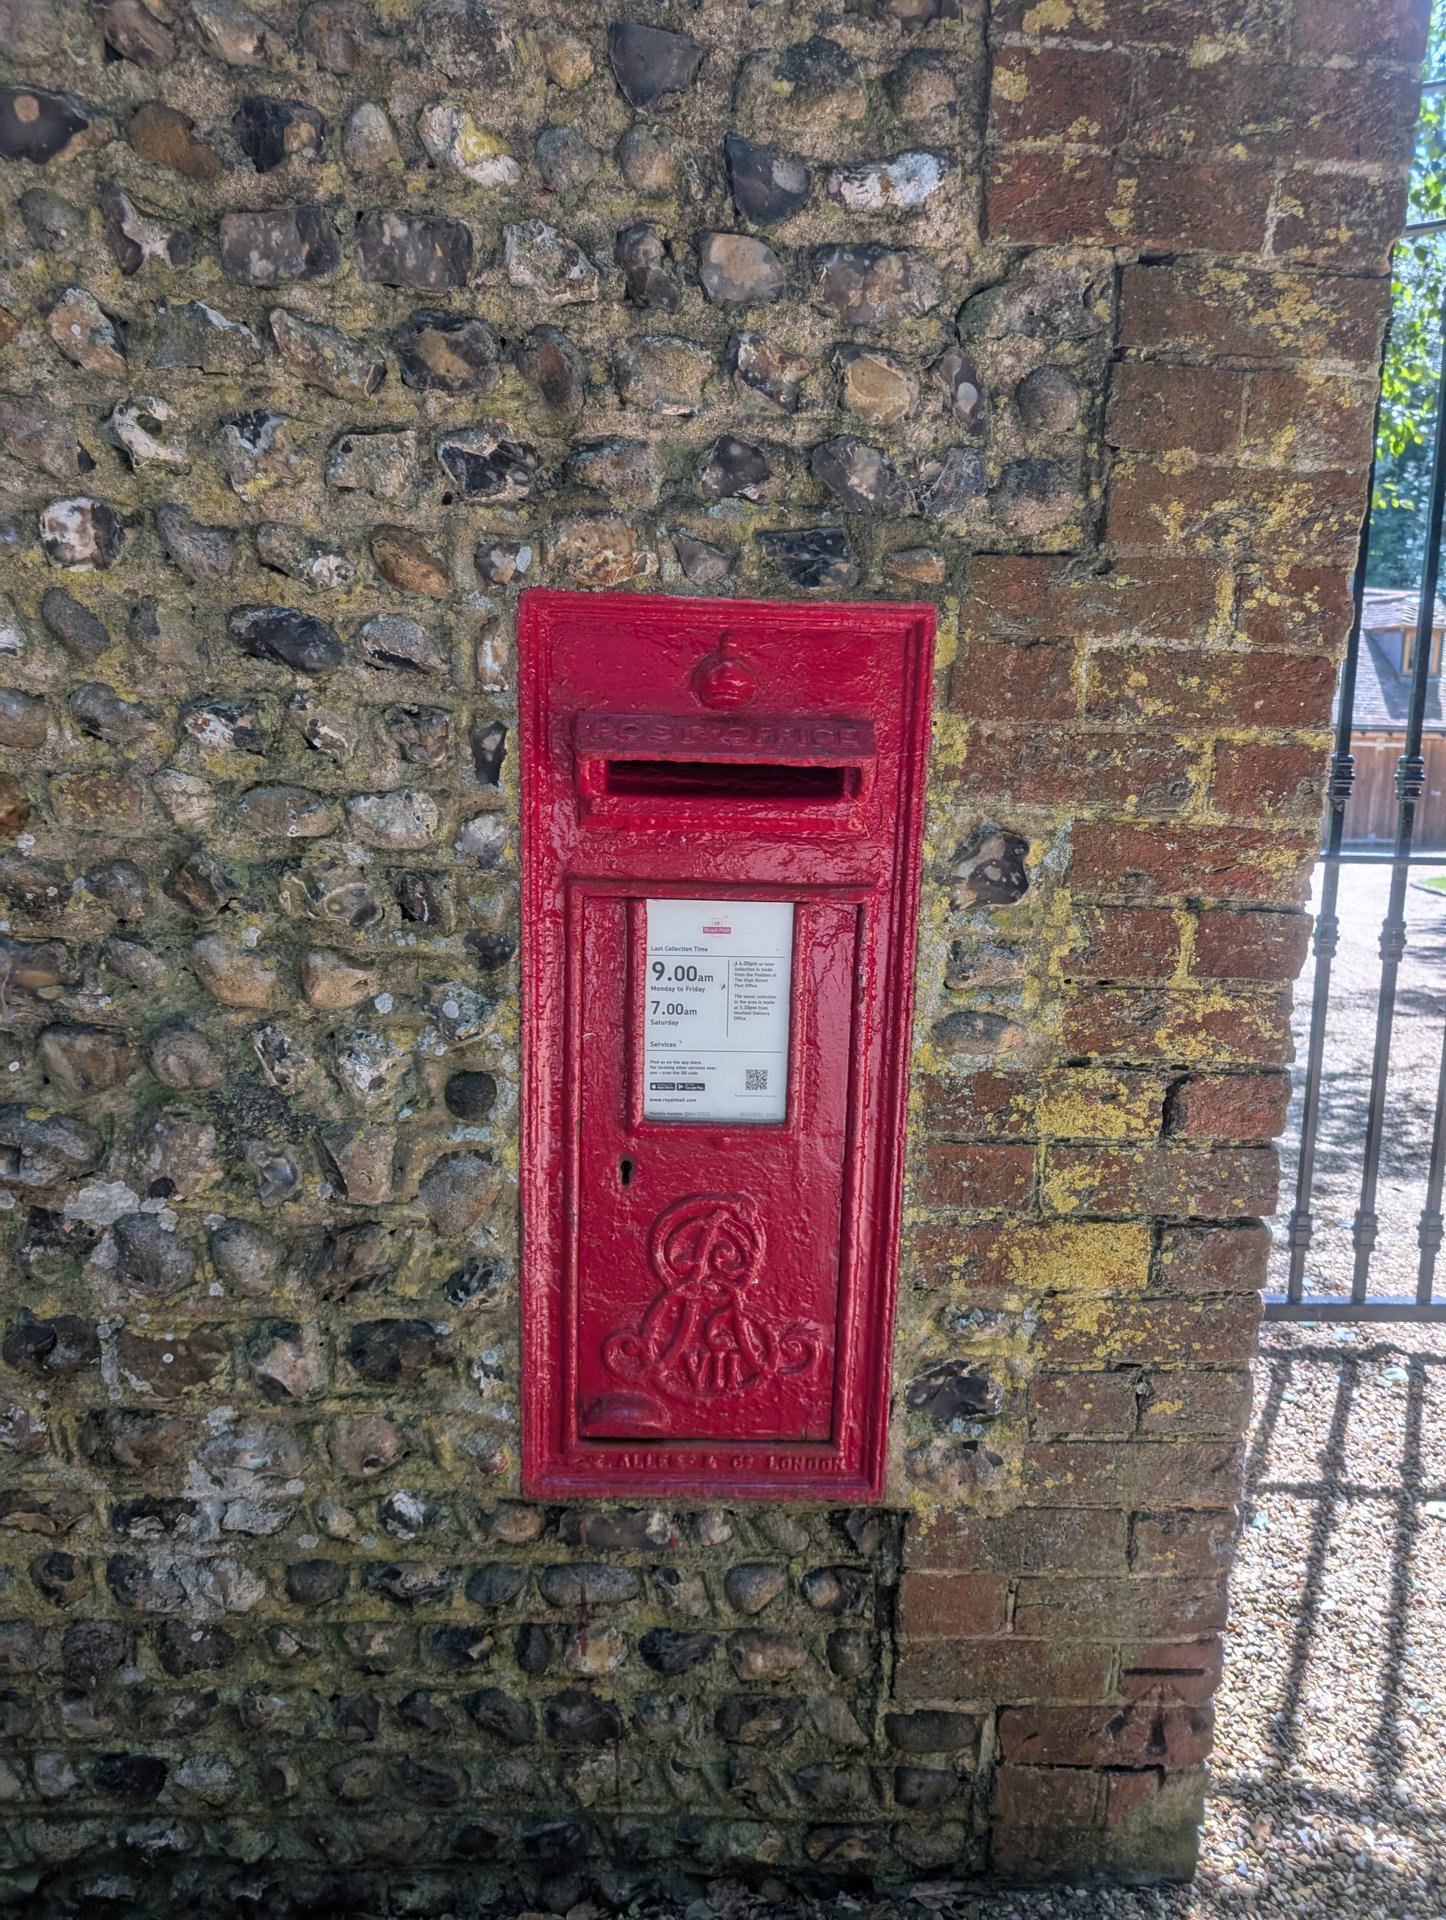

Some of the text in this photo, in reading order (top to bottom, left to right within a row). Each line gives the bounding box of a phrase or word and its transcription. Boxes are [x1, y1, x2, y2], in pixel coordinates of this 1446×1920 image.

[652, 961, 714, 982] 9.00am
[650, 1000, 698, 1015] 7.00am
[769, 1454, 848, 1471] LONDON
